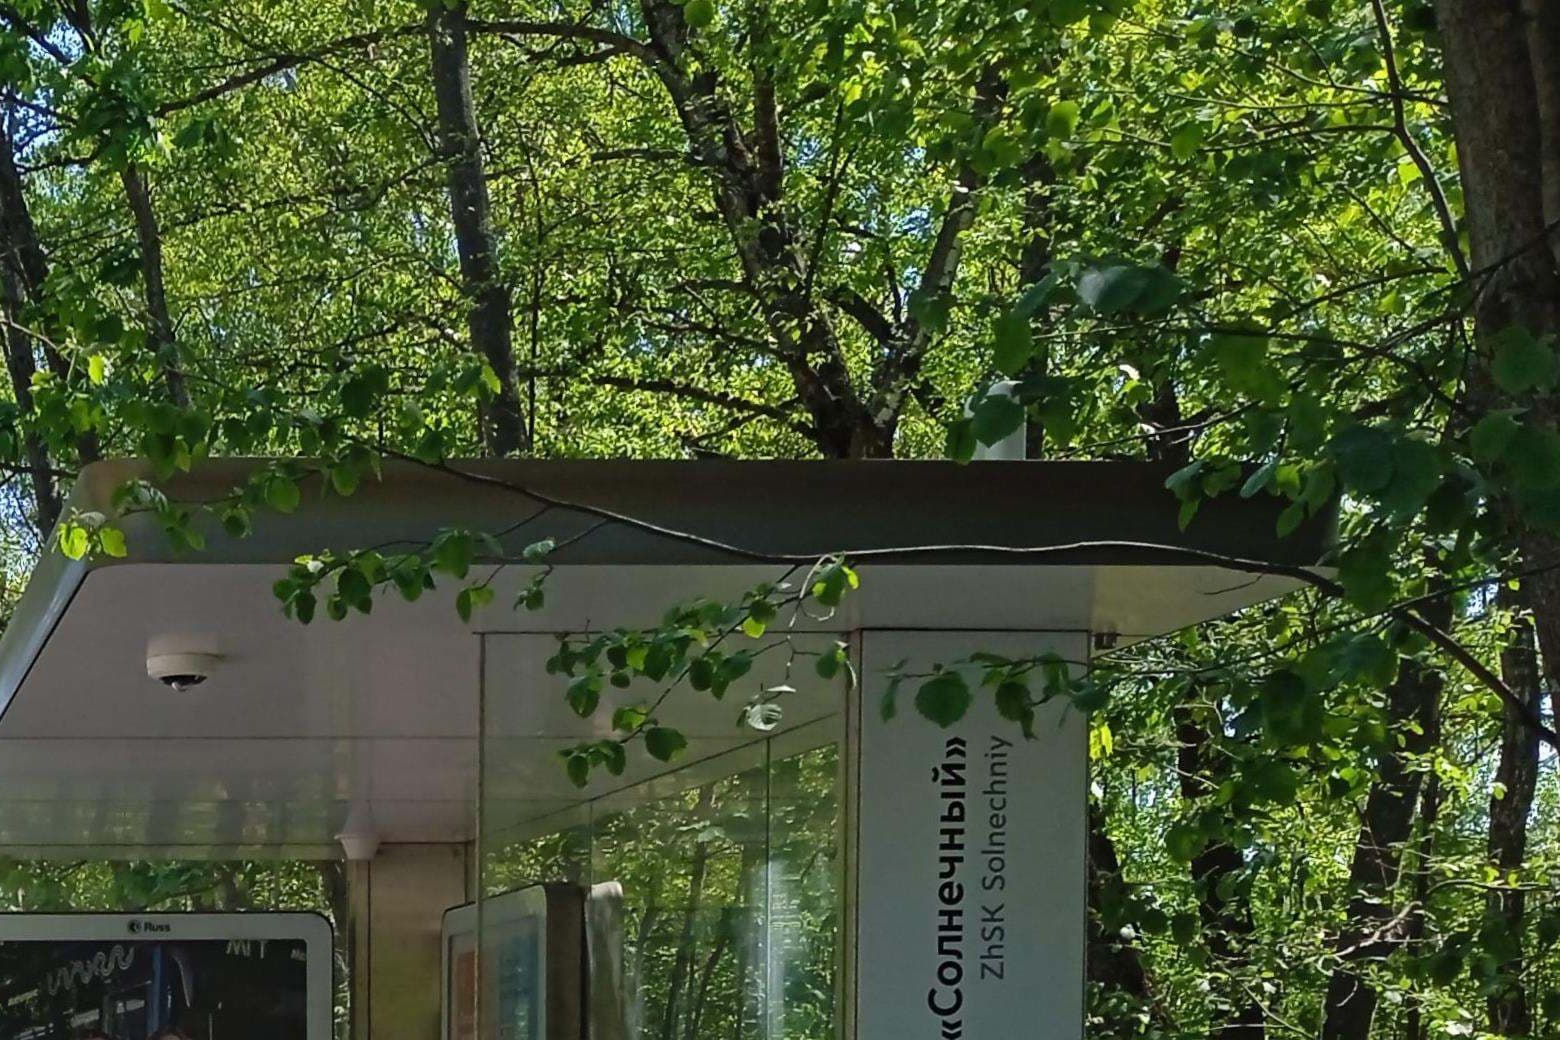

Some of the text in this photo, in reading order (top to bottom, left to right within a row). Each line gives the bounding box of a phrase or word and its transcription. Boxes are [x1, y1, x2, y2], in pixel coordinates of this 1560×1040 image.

[980, 735, 1014, 980] ZhSK Solnechniy
[143, 922, 171, 933] Russ
